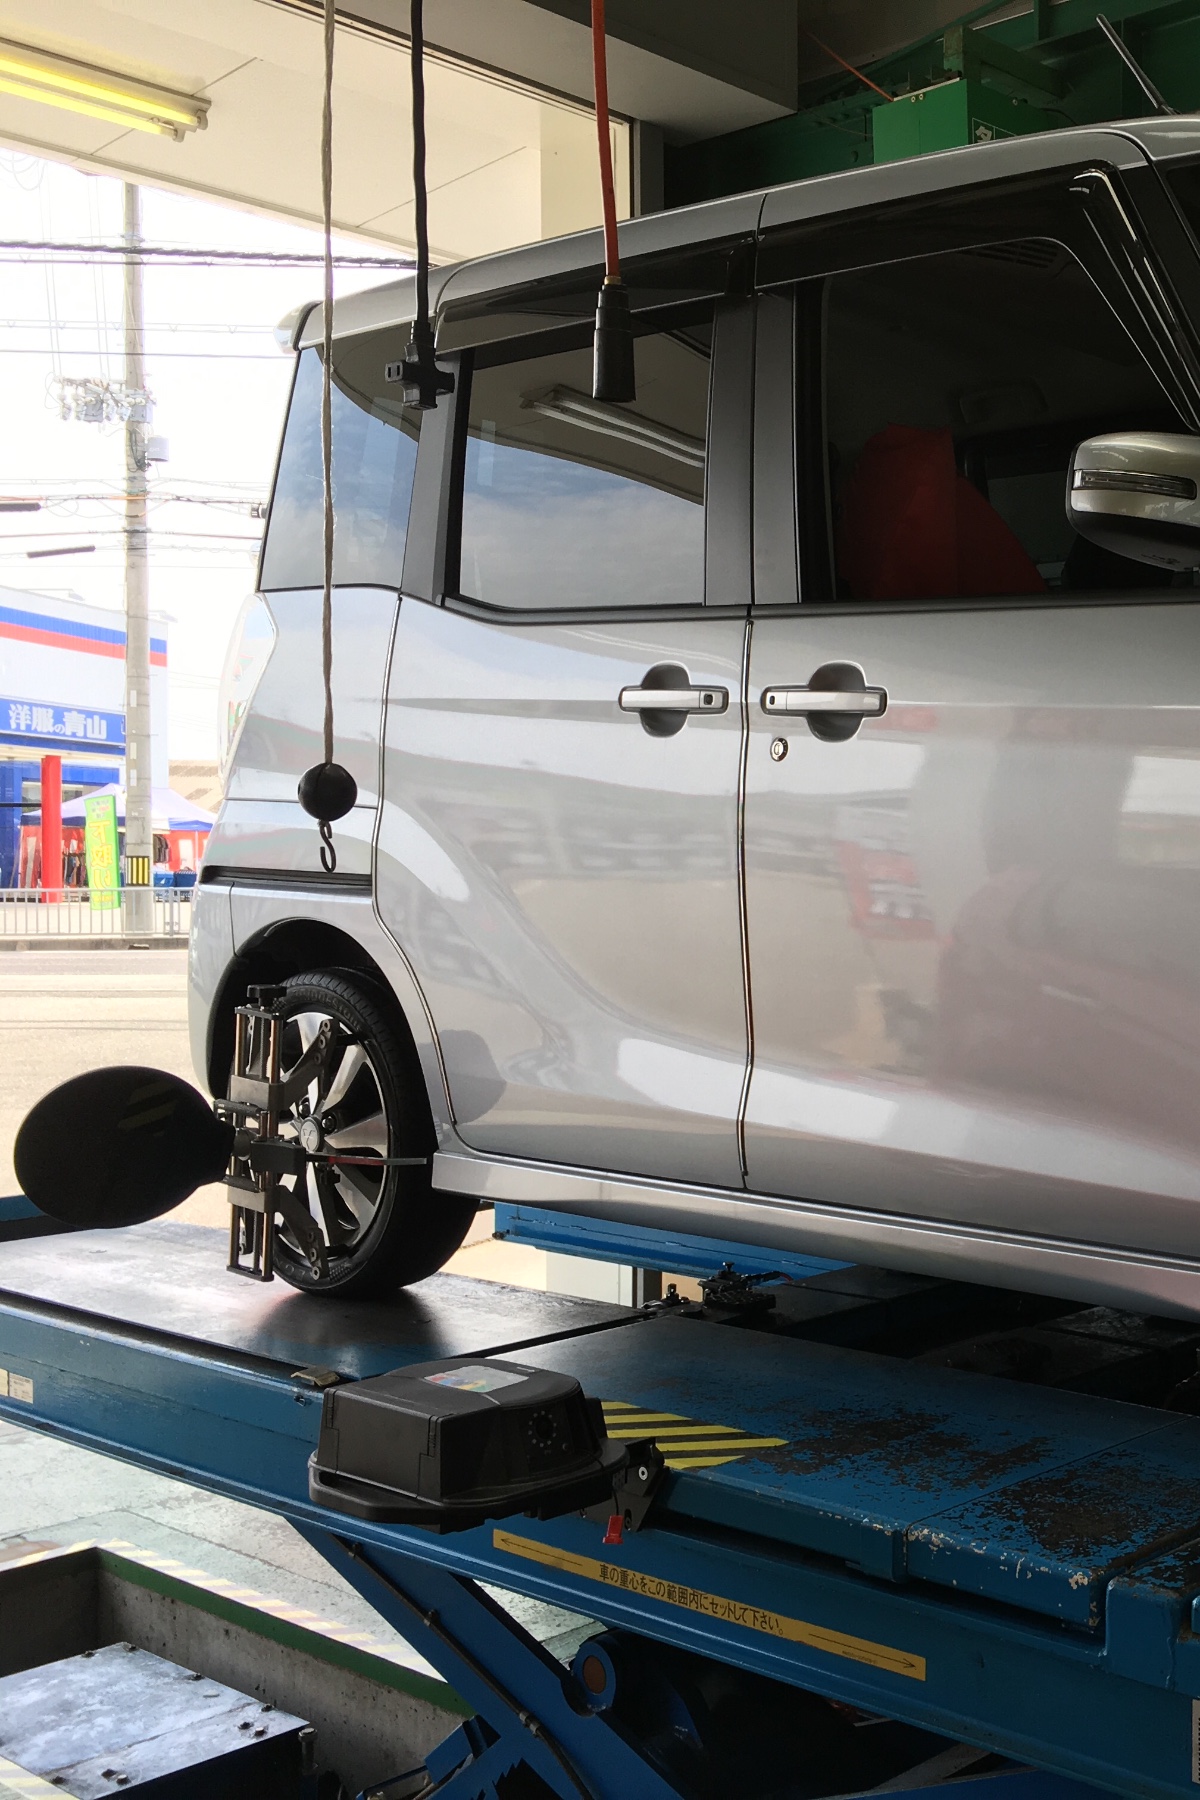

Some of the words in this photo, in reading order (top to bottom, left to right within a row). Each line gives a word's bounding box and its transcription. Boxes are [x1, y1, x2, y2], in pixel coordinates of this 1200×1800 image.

[8, 703, 107, 740] 洋服の青山
[599, 1563, 784, 1636] 車の重心をこの範囲内にセットして下さい。
